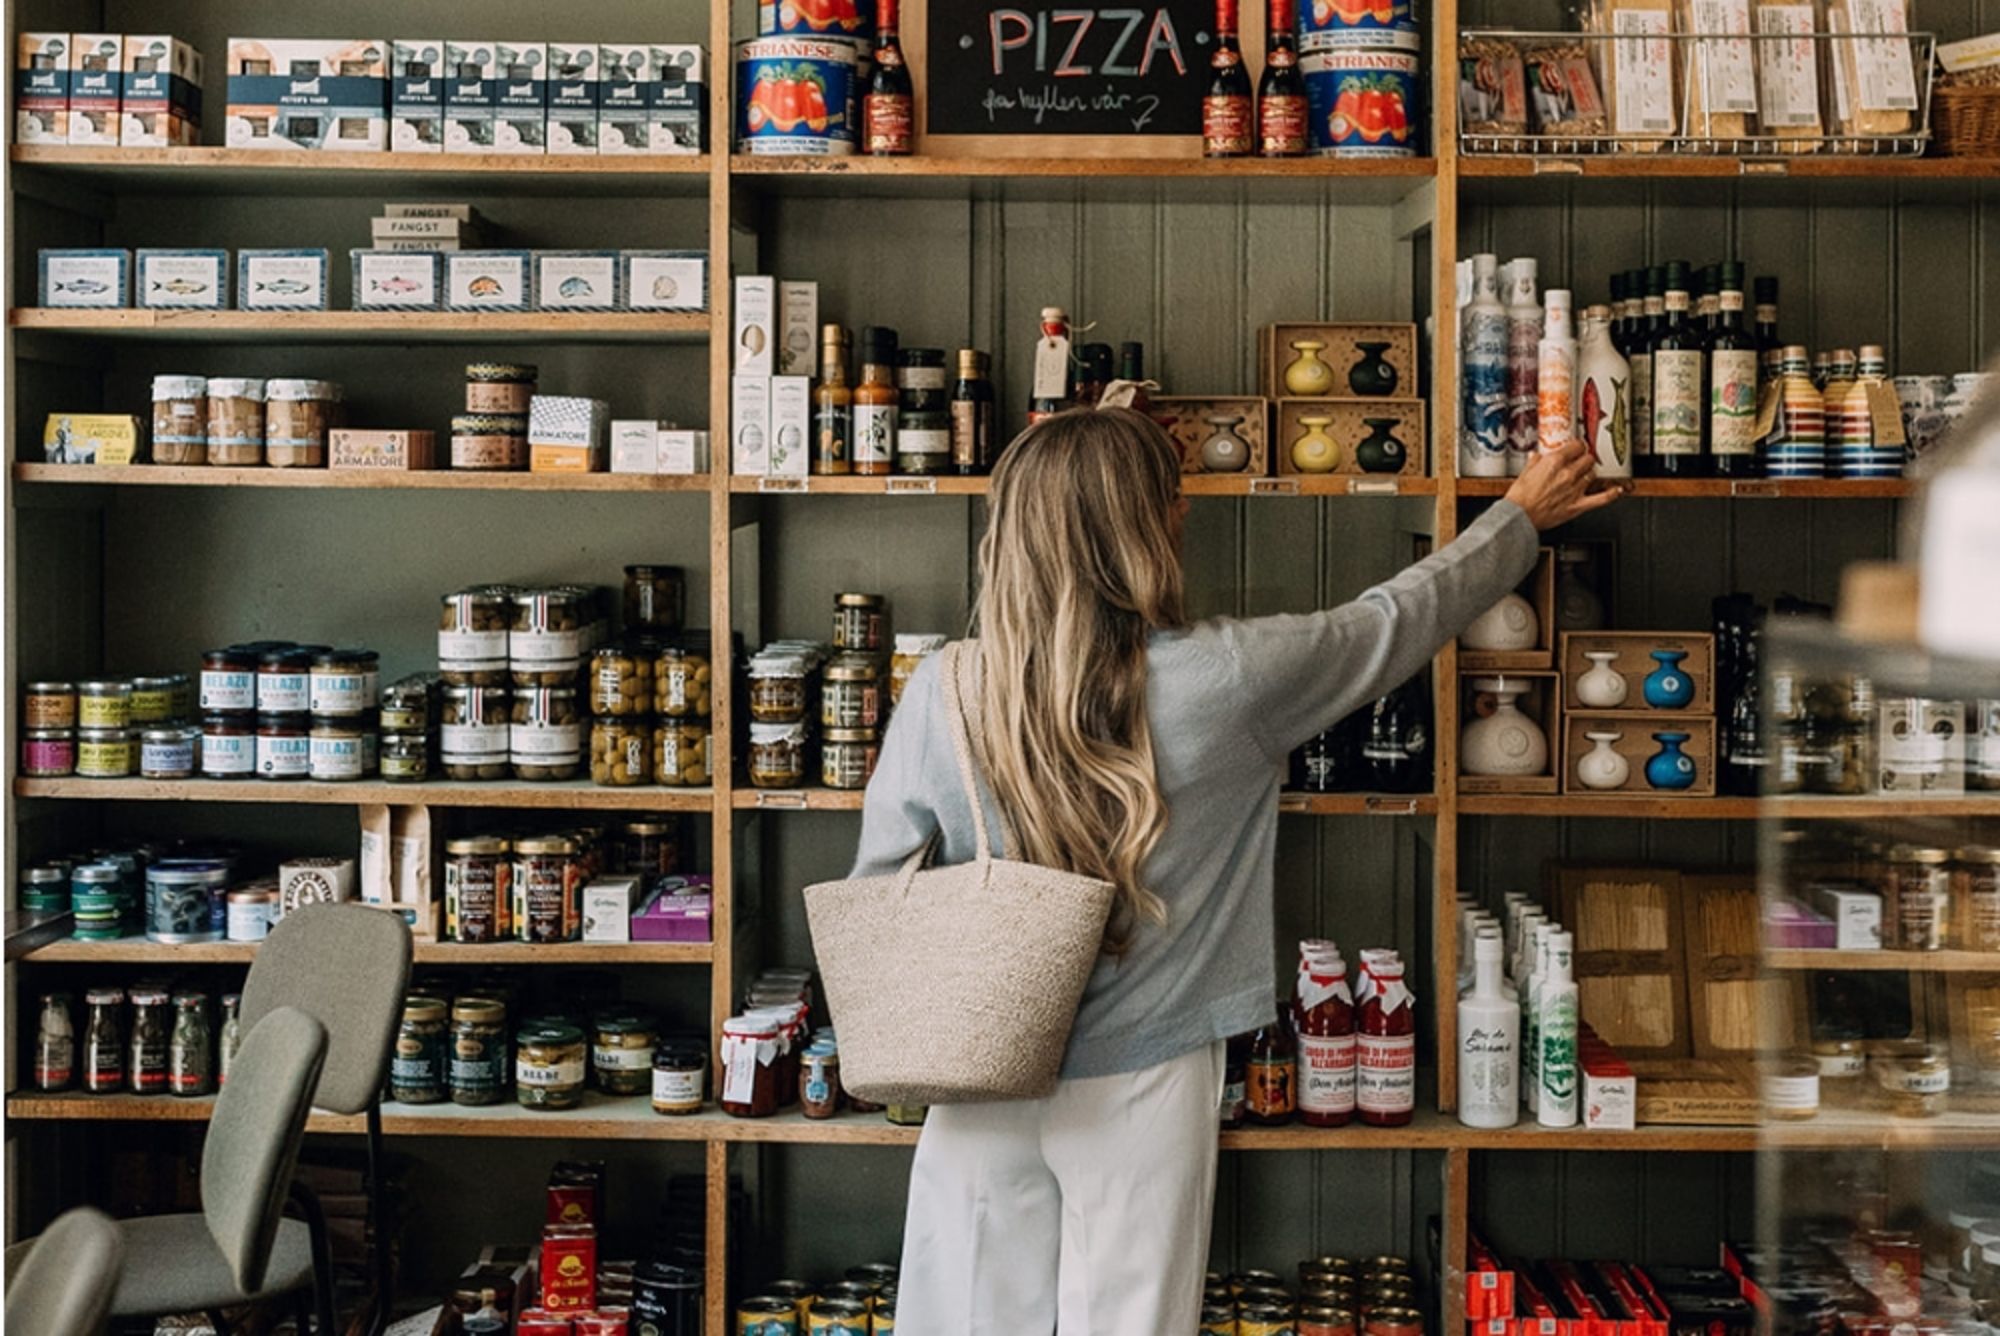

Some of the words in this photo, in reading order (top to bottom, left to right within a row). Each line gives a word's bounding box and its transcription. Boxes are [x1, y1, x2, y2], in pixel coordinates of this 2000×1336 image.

[988, 8, 1187, 77] PIZZA
[742, 41, 835, 58] STRIANESE
[1091, 84, 1130, 111] vår
[403, 208, 450, 218] FANGST
[391, 222, 439, 233] FANGST
[532, 430, 586, 441] ARMATORE
[334, 455, 404, 467] ARMATORE
[205, 675, 249, 688] BELAZU
